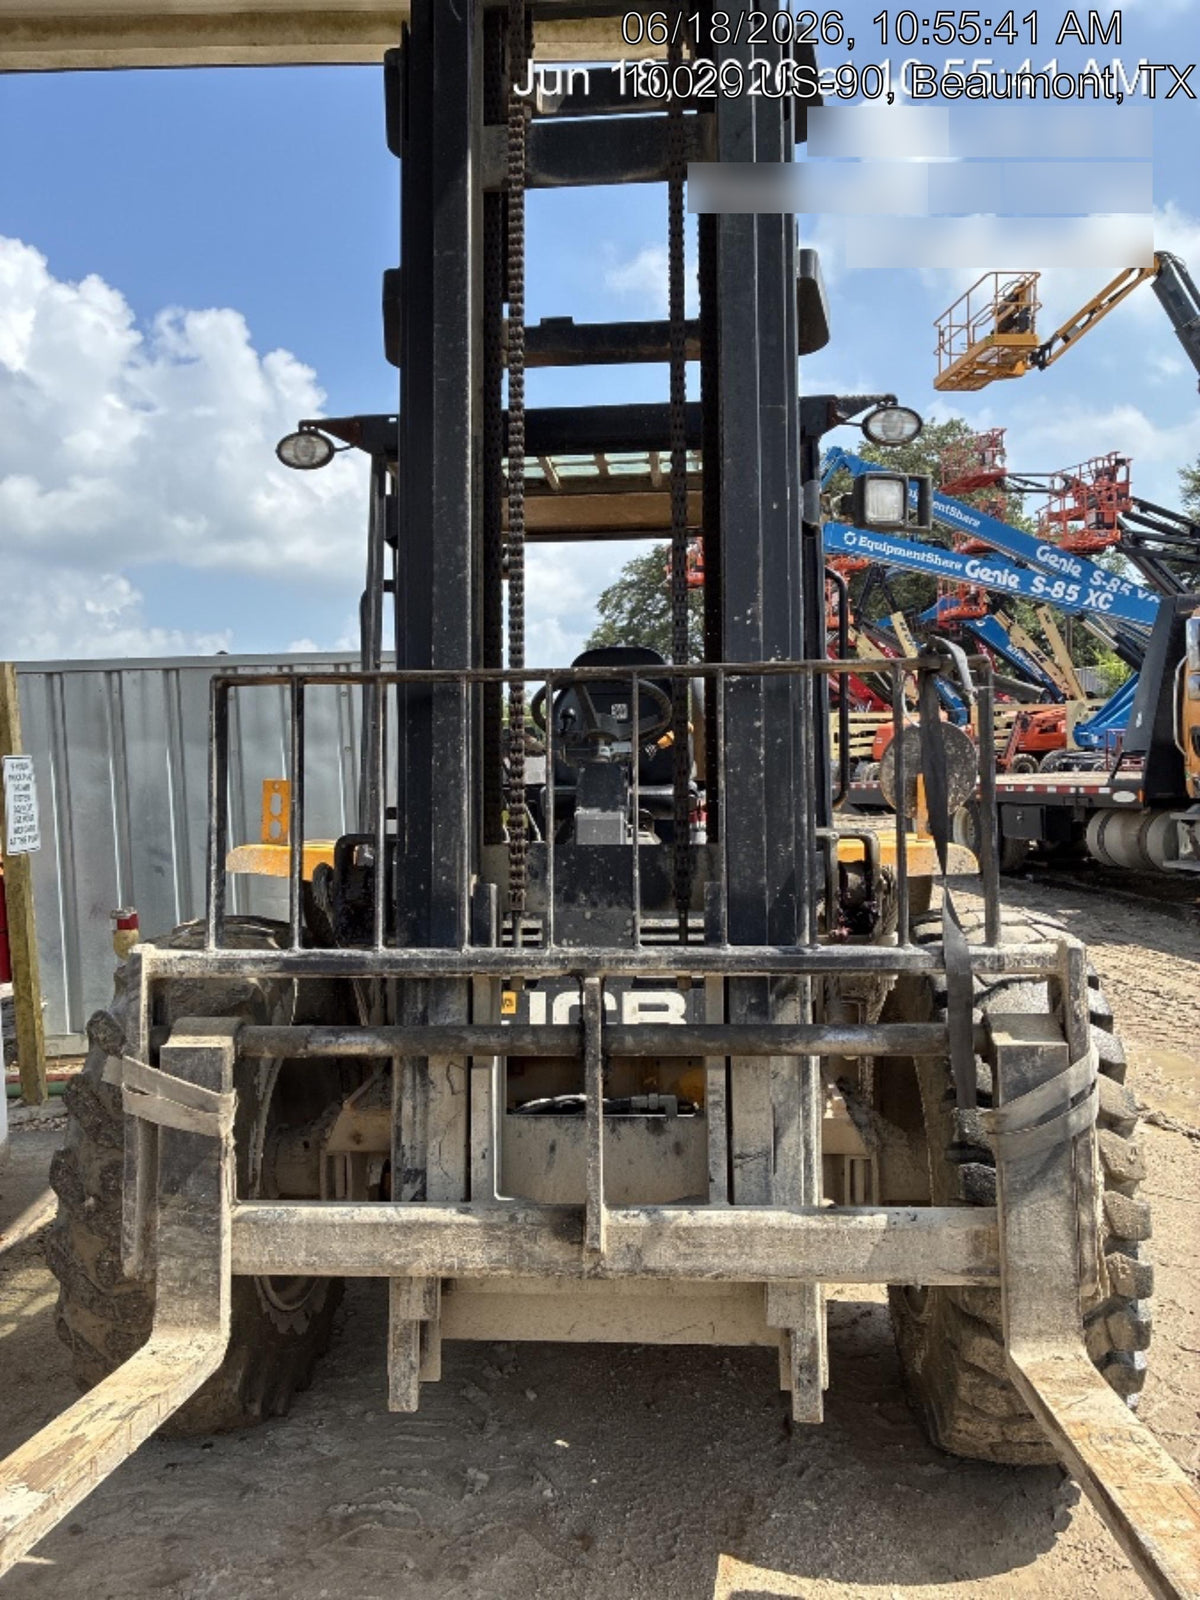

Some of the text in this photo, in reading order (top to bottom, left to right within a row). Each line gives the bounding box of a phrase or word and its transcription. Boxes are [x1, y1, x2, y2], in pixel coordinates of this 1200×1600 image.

[858, 535, 1114, 611] EquipmentShare Genie S-85 XC
[1036, 545, 1082, 579] Genie
